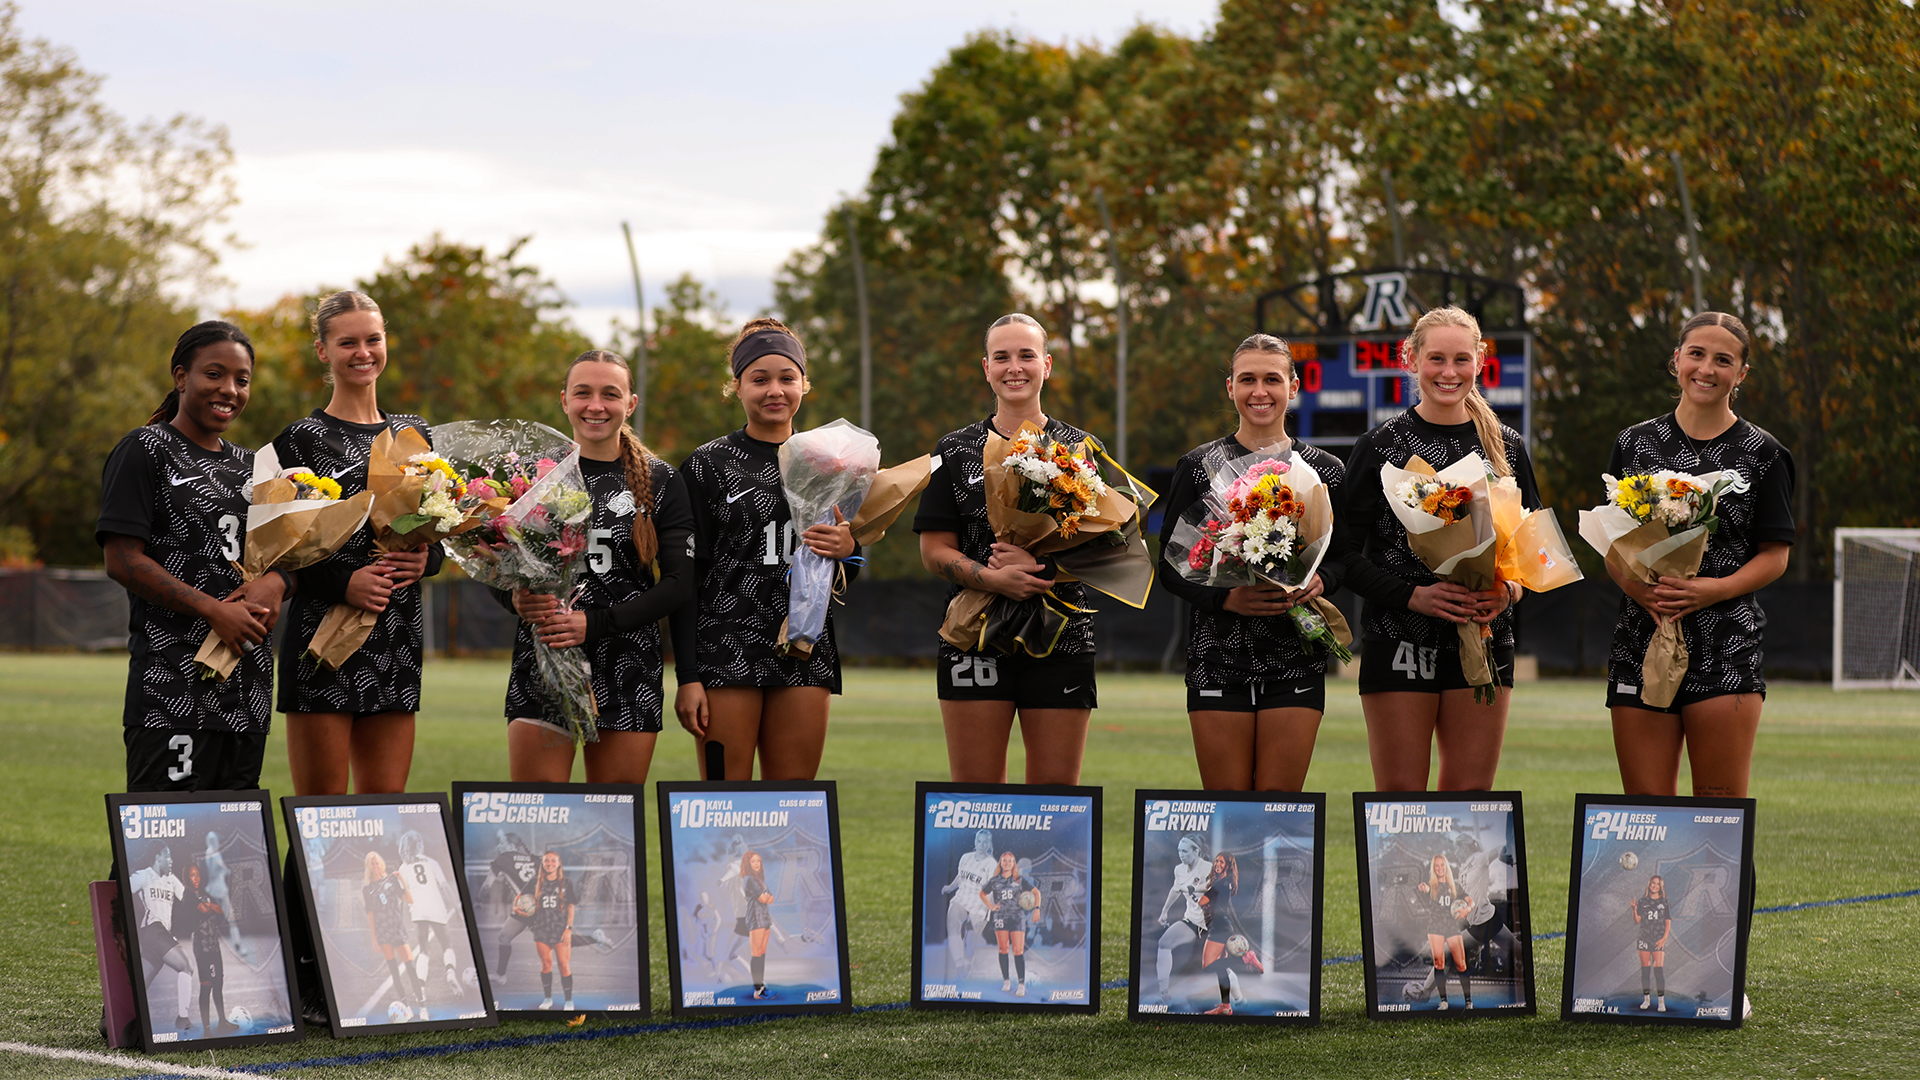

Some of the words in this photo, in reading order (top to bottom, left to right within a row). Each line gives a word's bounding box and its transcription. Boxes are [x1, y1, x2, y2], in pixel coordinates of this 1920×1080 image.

[1360, 271, 1412, 332] R
[1303, 361, 1322, 393] 0
[1482, 356, 1500, 388] 0
[218, 514, 240, 561] 3
[763, 520, 799, 565] 10
[580, 529, 612, 574] 5
[1392, 641, 1437, 680] 40
[950, 656, 999, 687] 26
[168, 735, 193, 781] 3
[508, 794, 544, 805] AMBER
[584, 795, 606, 803] CLASS
[608, 795, 616, 803] OF
[706, 800, 732, 810] KAYLA
[808, 800, 823, 808] 2027
[144, 806, 167, 818] MAYA
[220, 803, 238, 812] CLASS
[239, 803, 247, 812] OF
[398, 806, 416, 814] CLASS
[418, 805, 426, 814] OF
[672, 799, 706, 828] #10
[971, 802, 1012, 813] ISABELLE
[1040, 804, 1060, 812] CLASS
[1070, 805, 1087, 813] 2027
[1171, 802, 1216, 814] CADANCE
[1264, 804, 1286, 812] CLASS
[1298, 804, 1315, 812] 2027
[1404, 805, 1426, 815] DREA
[320, 808, 357, 820] DELANEY
[506, 806, 570, 824] CASNER
[705, 811, 788, 828] FRANCILLON
[928, 800, 972, 828] #26
[1629, 814, 1657, 824] REESE
[968, 814, 1053, 830] DALYRMPLE
[1167, 815, 1210, 831] RYAN
[1403, 816, 1452, 833] DWYER
[1586, 812, 1629, 840] #24
[144, 819, 185, 838] LEACH
[320, 819, 384, 838] SCANLON
[1626, 825, 1667, 841] HATIN
[414, 864, 427, 884] 8
[1001, 890, 1014, 900] 26
[1438, 896, 1451, 906] 40
[542, 896, 557, 908] 25
[1648, 910, 1659, 920] 24
[1638, 940, 1648, 950] 24
[1138, 1004, 1168, 1013] ORWARD
[340, 1018, 366, 1028] ORWARD
[152, 1032, 178, 1044] ORWARD
